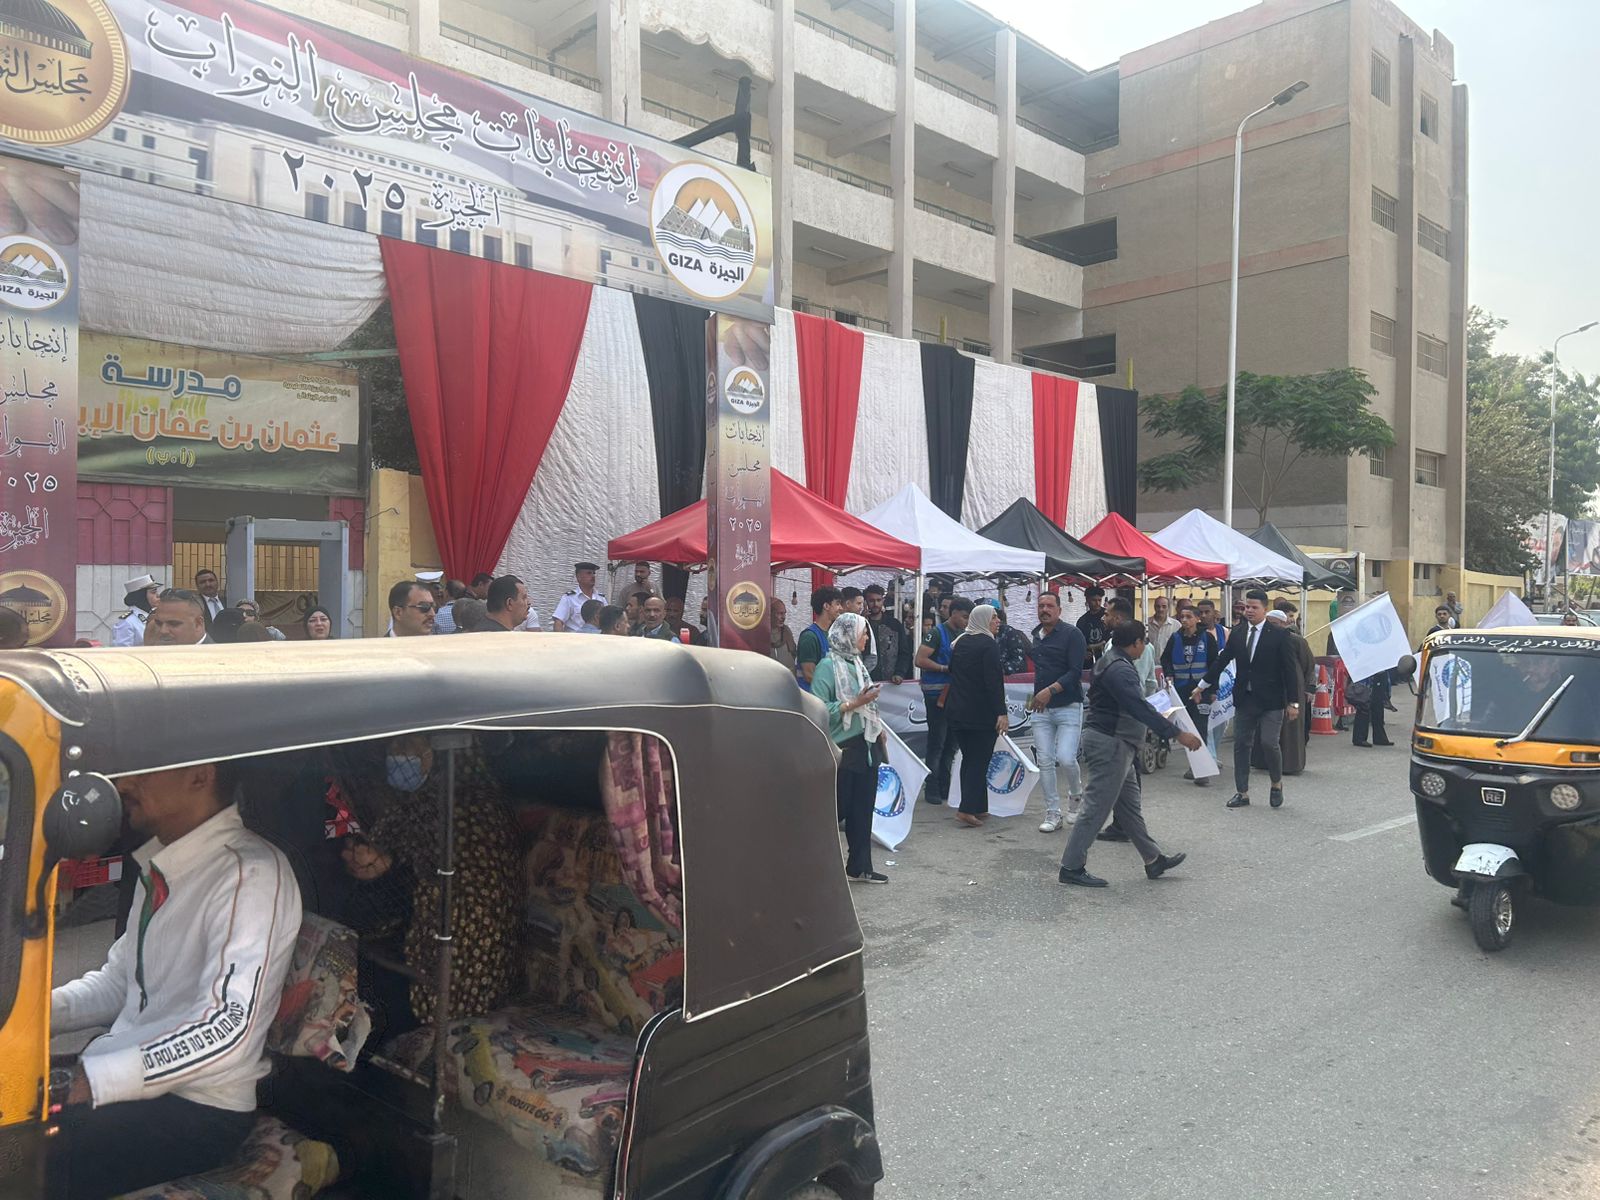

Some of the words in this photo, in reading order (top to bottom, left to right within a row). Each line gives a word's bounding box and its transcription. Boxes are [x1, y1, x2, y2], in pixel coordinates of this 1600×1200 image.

[147, 10, 320, 107] النواب
[326, 72, 464, 151] مجلس
[281, 149, 405, 211] ٢٠٢٥
[421, 181, 500, 230] الجيزة
[668, 252, 703, 272] GIZA
[709, 261, 744, 283] الجيزة
[0, 285, 22, 295] IZA
[28, 289, 58, 300] الجيزة
[101, 353, 242, 399] مدرسة
[132, 405, 212, 442] عفان
[218, 415, 253, 450] بن
[259, 419, 340, 453] عثمان
[729, 517, 762, 533] ٢٠٢٥
[1486, 793, 1501, 802] RE
[153, 1040, 191, 1067] RULES
[187, 1034, 205, 1052] NO
[534, 1108, 553, 1122] 66
